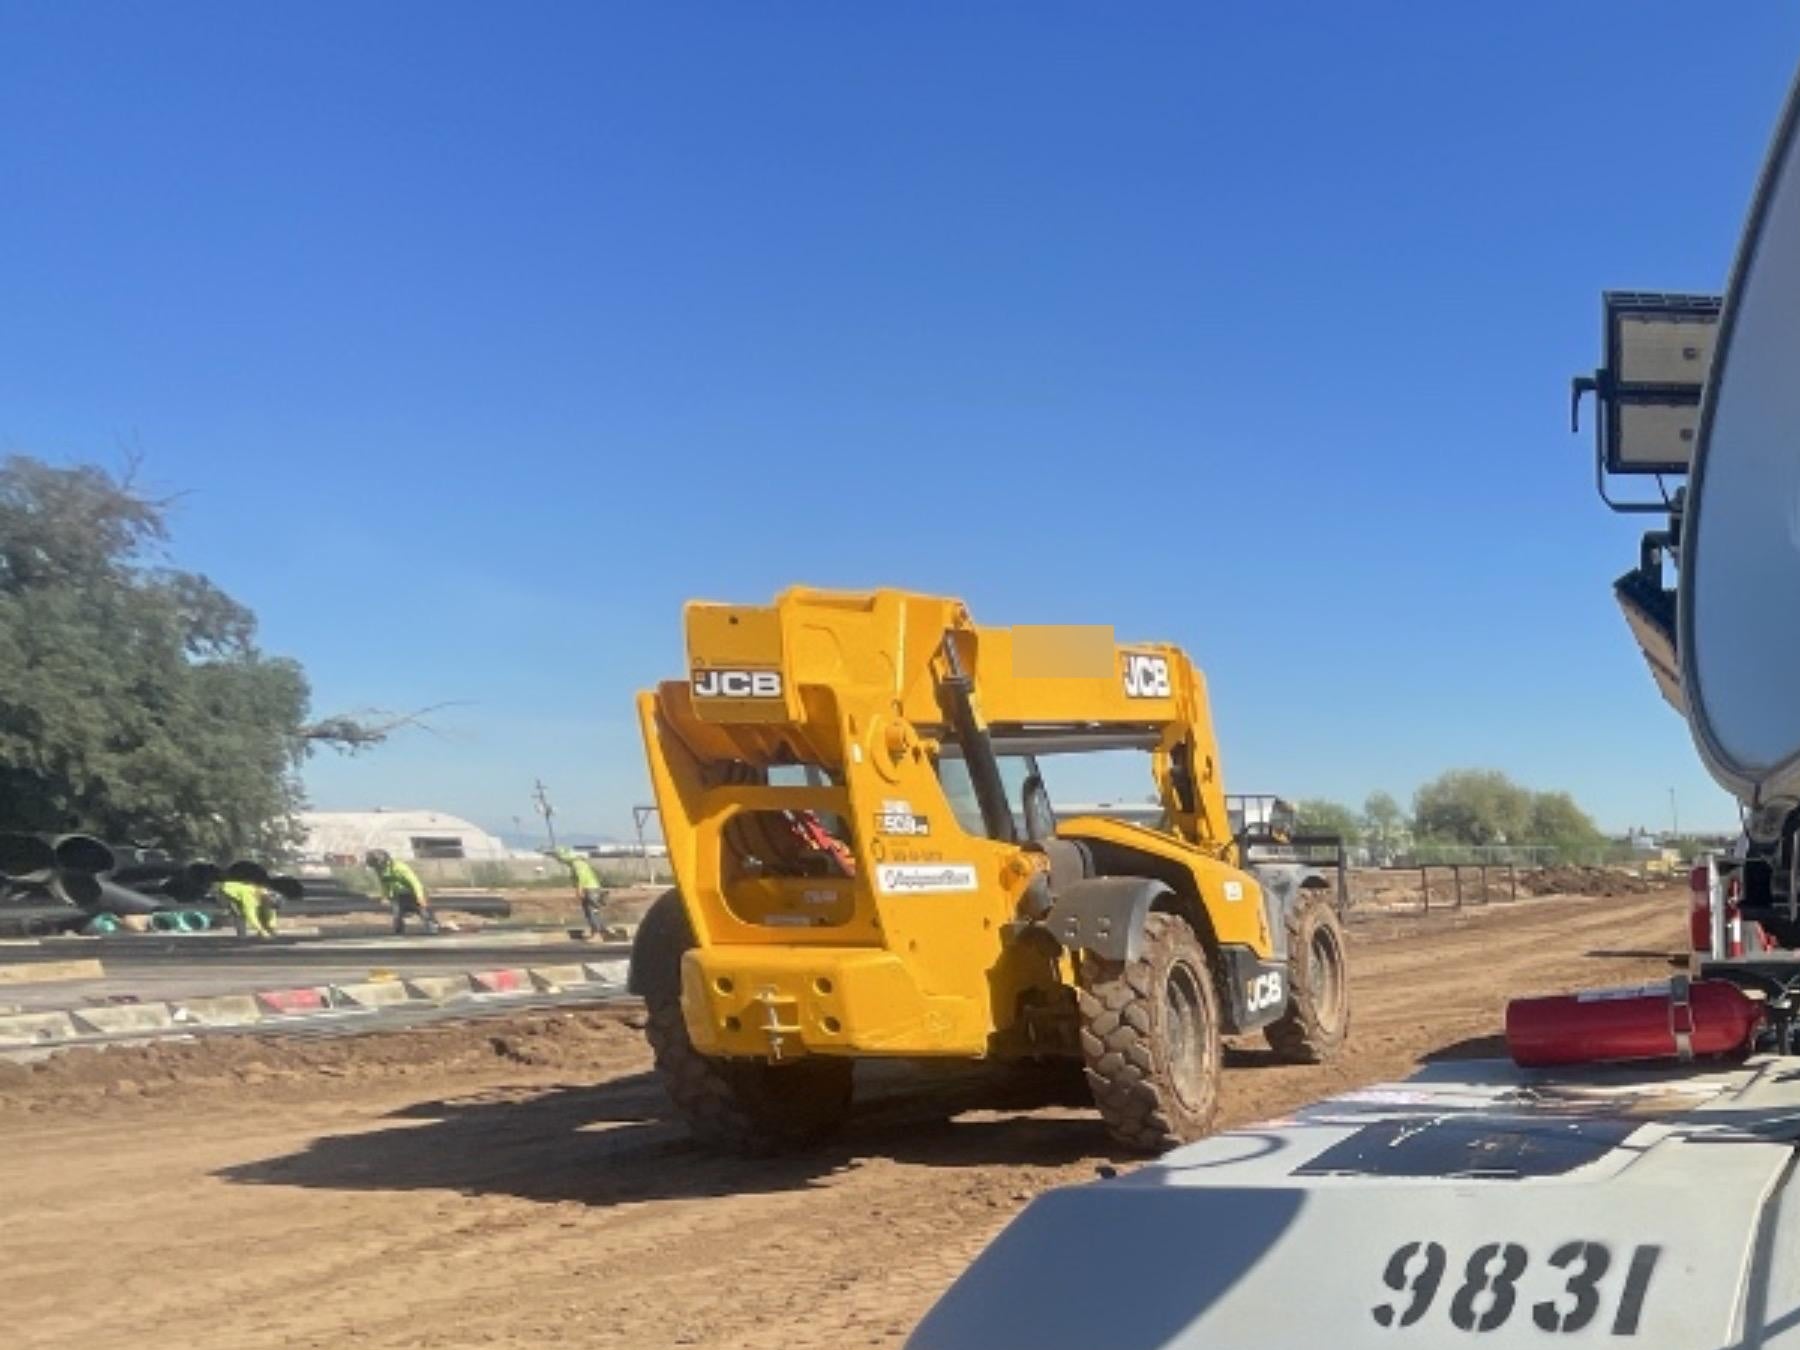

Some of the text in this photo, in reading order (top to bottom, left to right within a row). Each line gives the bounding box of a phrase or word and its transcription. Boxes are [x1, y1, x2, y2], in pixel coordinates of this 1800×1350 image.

[695, 671, 781, 697] JCB
[1125, 655, 1171, 697] JCB
[1248, 971, 1282, 1012] JCB
[1371, 1240, 1662, 1335] 9831
